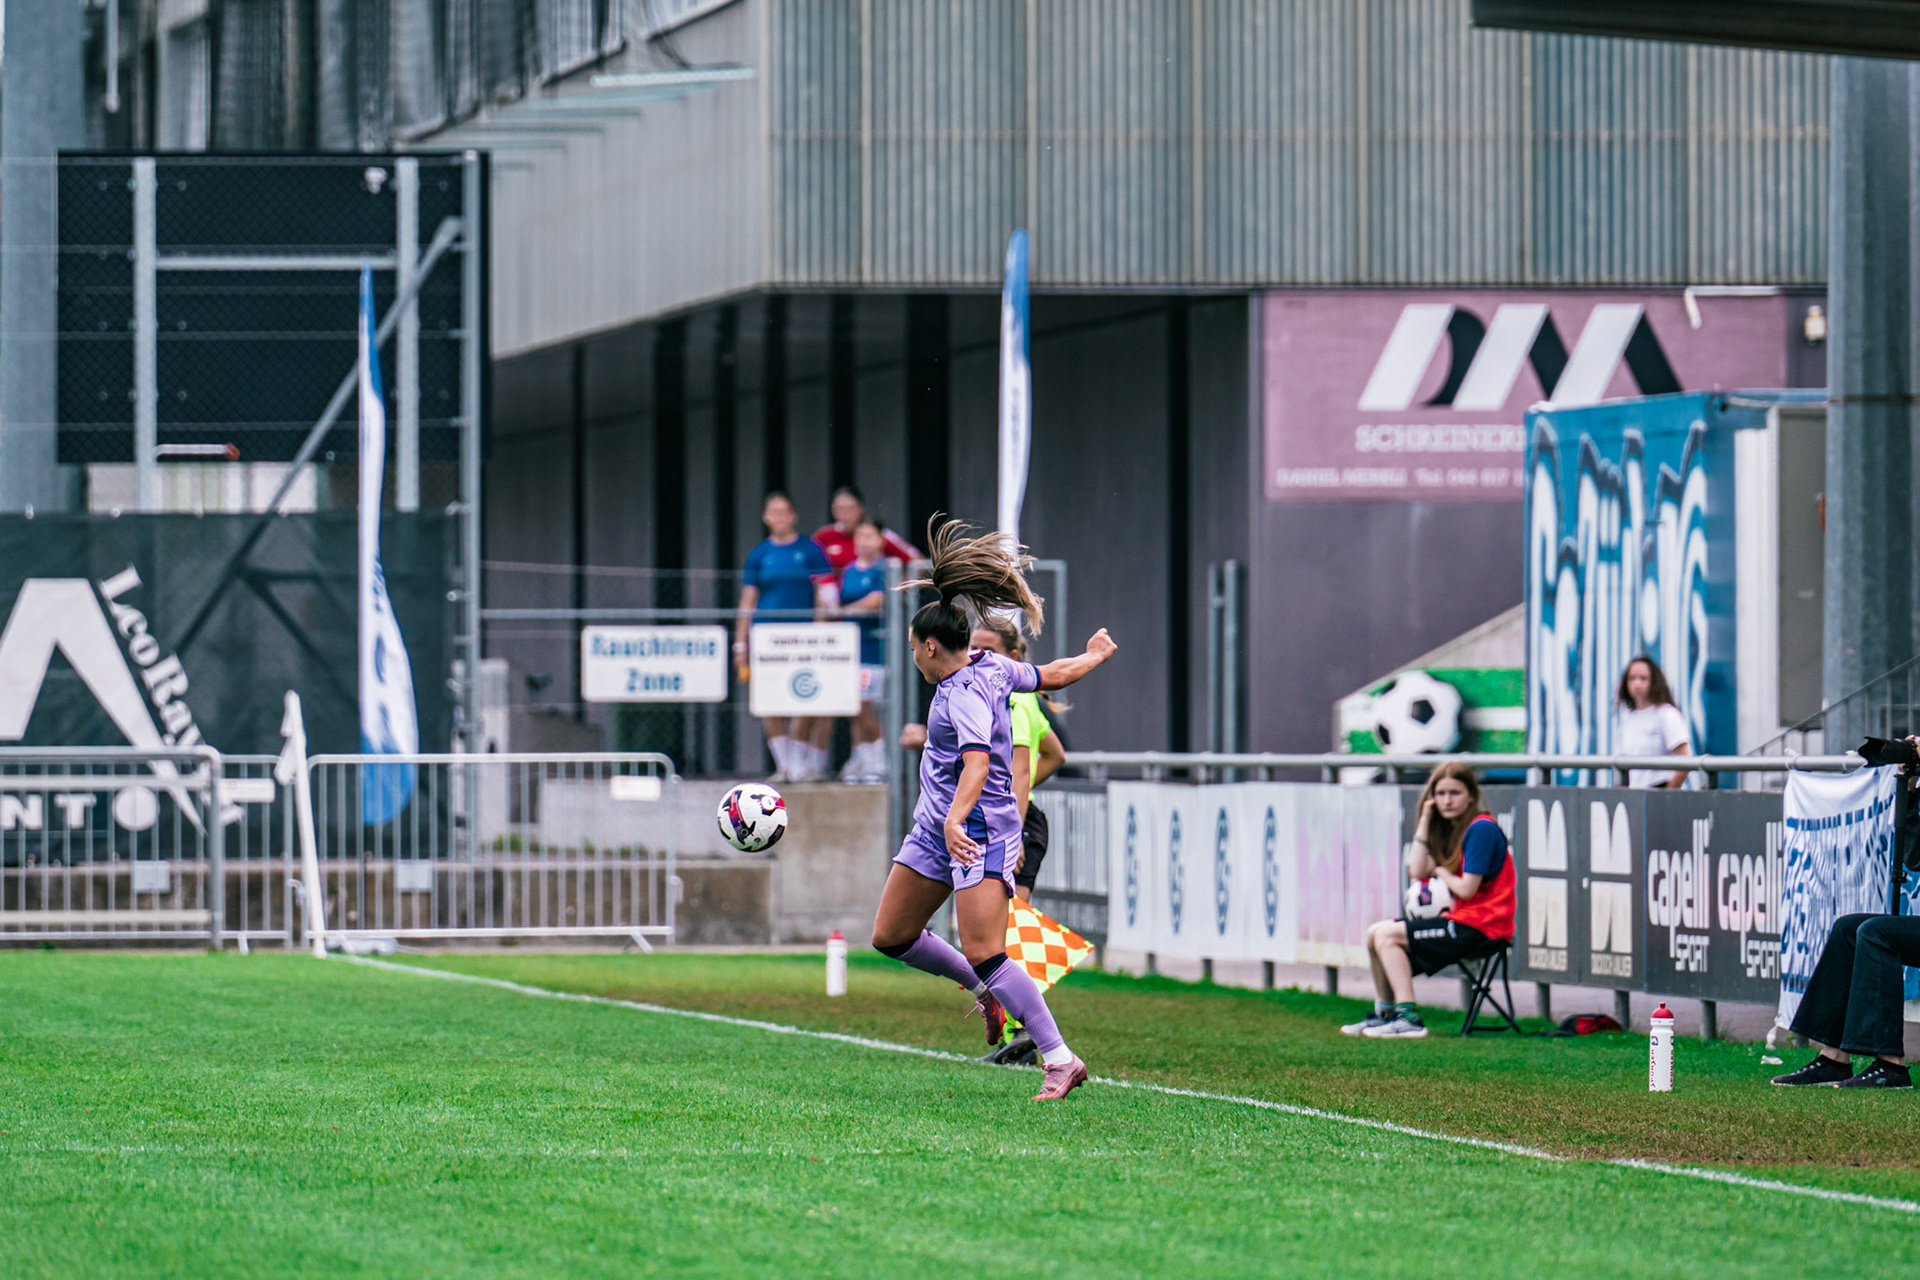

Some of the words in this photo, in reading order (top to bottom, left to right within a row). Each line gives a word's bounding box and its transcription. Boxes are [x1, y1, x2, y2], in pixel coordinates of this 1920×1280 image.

[626, 667, 682, 691] Zone
[1648, 818, 1710, 958] capelli
[1717, 821, 1783, 965] capelli
[1675, 933, 1710, 973] SPORT
